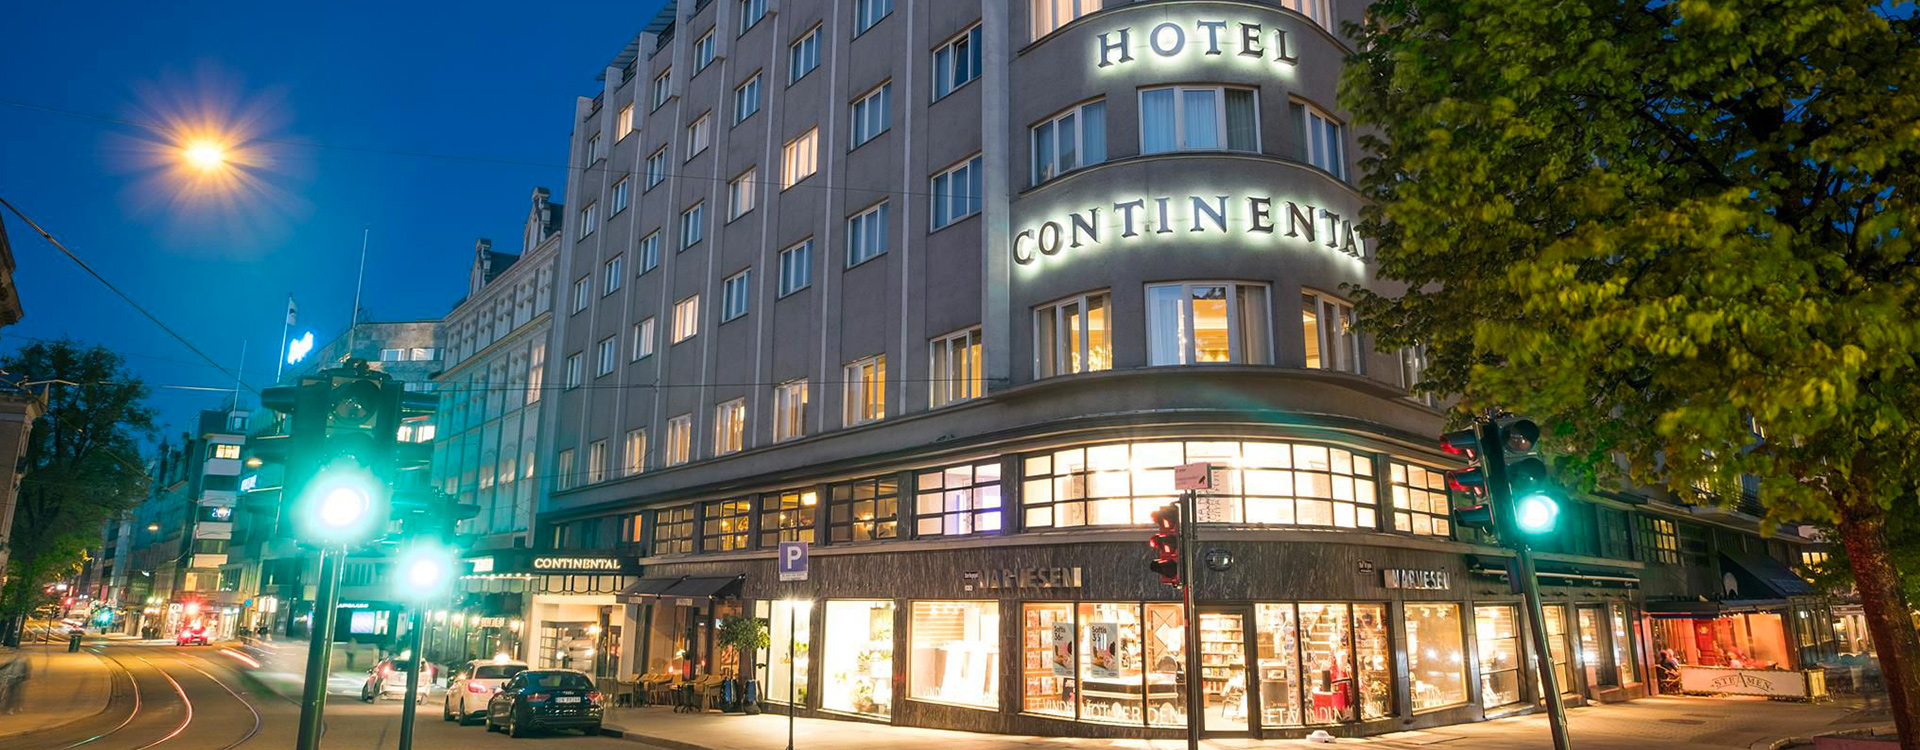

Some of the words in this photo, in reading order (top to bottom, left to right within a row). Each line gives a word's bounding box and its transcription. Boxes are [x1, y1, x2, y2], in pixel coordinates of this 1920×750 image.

[1097, 19, 1299, 68] HOTEL
[533, 557, 622, 570] CONTINENTAL
[787, 546, 802, 570] P
[978, 567, 1080, 589] NARVESEN
[1389, 567, 1451, 590] NARVESEN
[1713, 672, 1771, 690] STEAMEN
